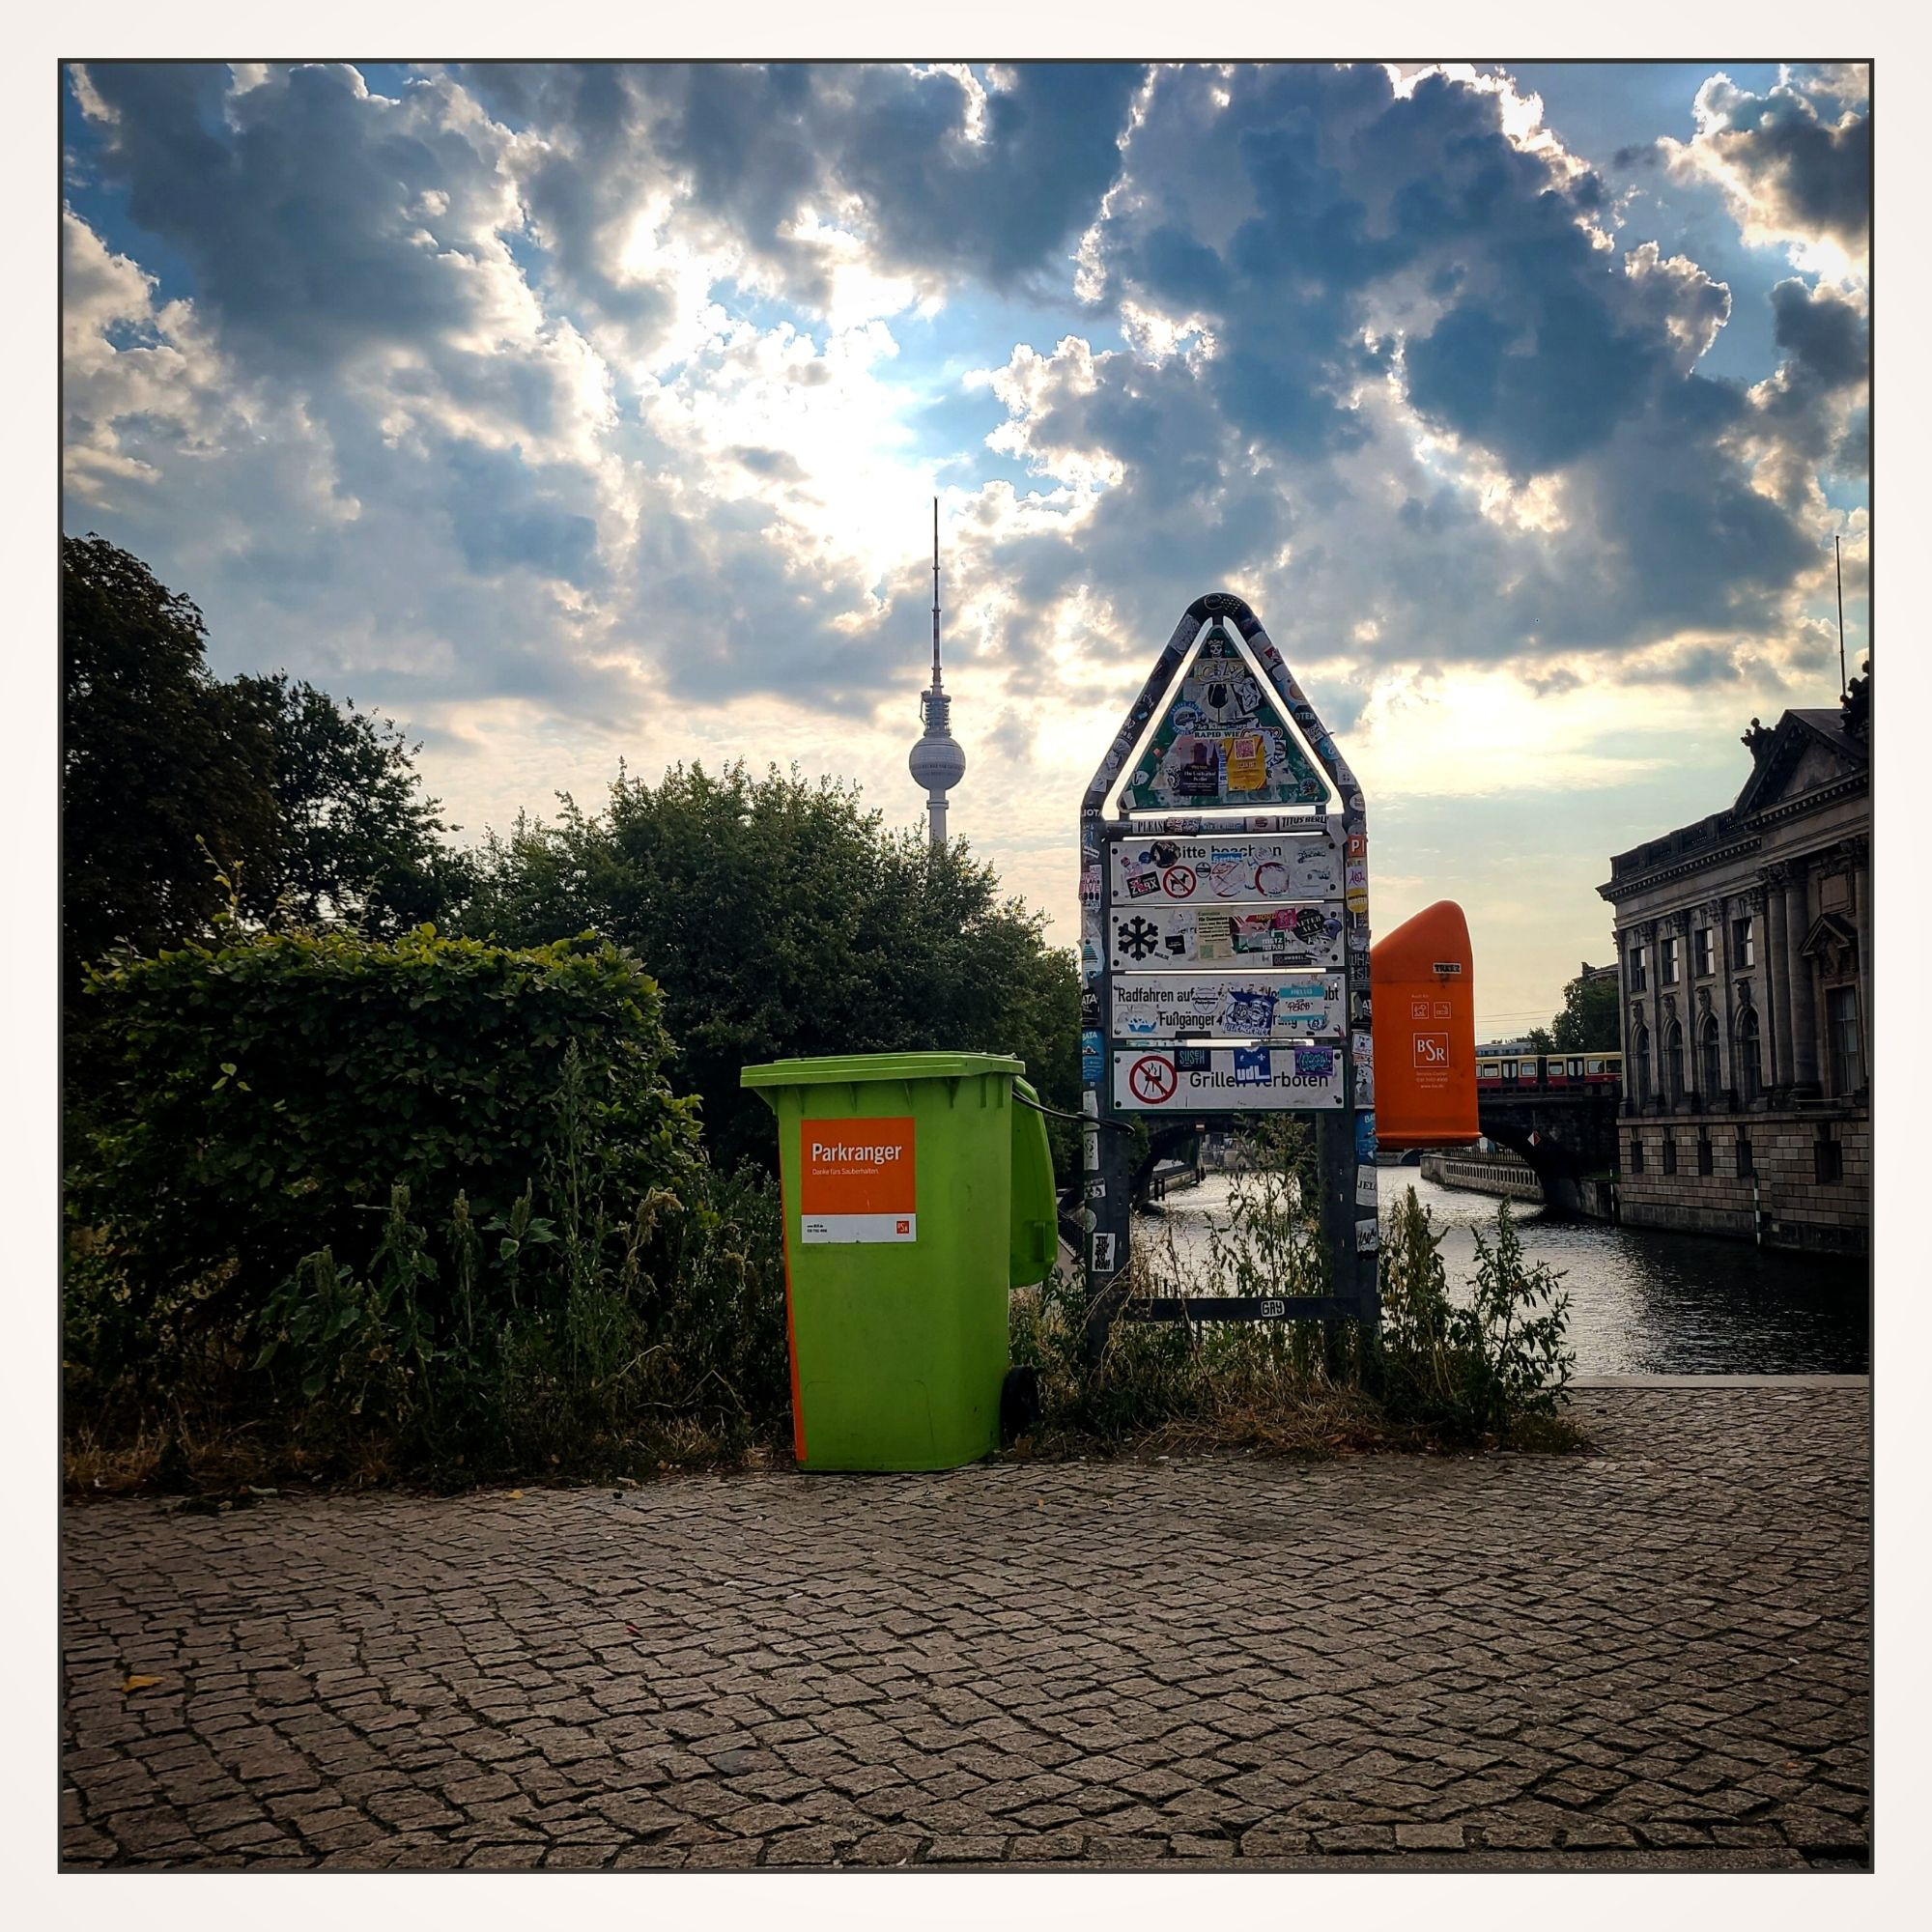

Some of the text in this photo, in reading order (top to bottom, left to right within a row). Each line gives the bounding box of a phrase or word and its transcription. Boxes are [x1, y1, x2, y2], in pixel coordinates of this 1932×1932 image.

[1137, 819, 1165, 831] PLEAS
[1282, 816, 1304, 828] TITUS
[1118, 986, 1175, 1003] Radfahren
[1158, 1009, 1216, 1030] Fußgänger
[1416, 1038, 1446, 1062] BSR
[1189, 1071, 1246, 1088] Grille
[812, 1142, 902, 1165] Parkranger
